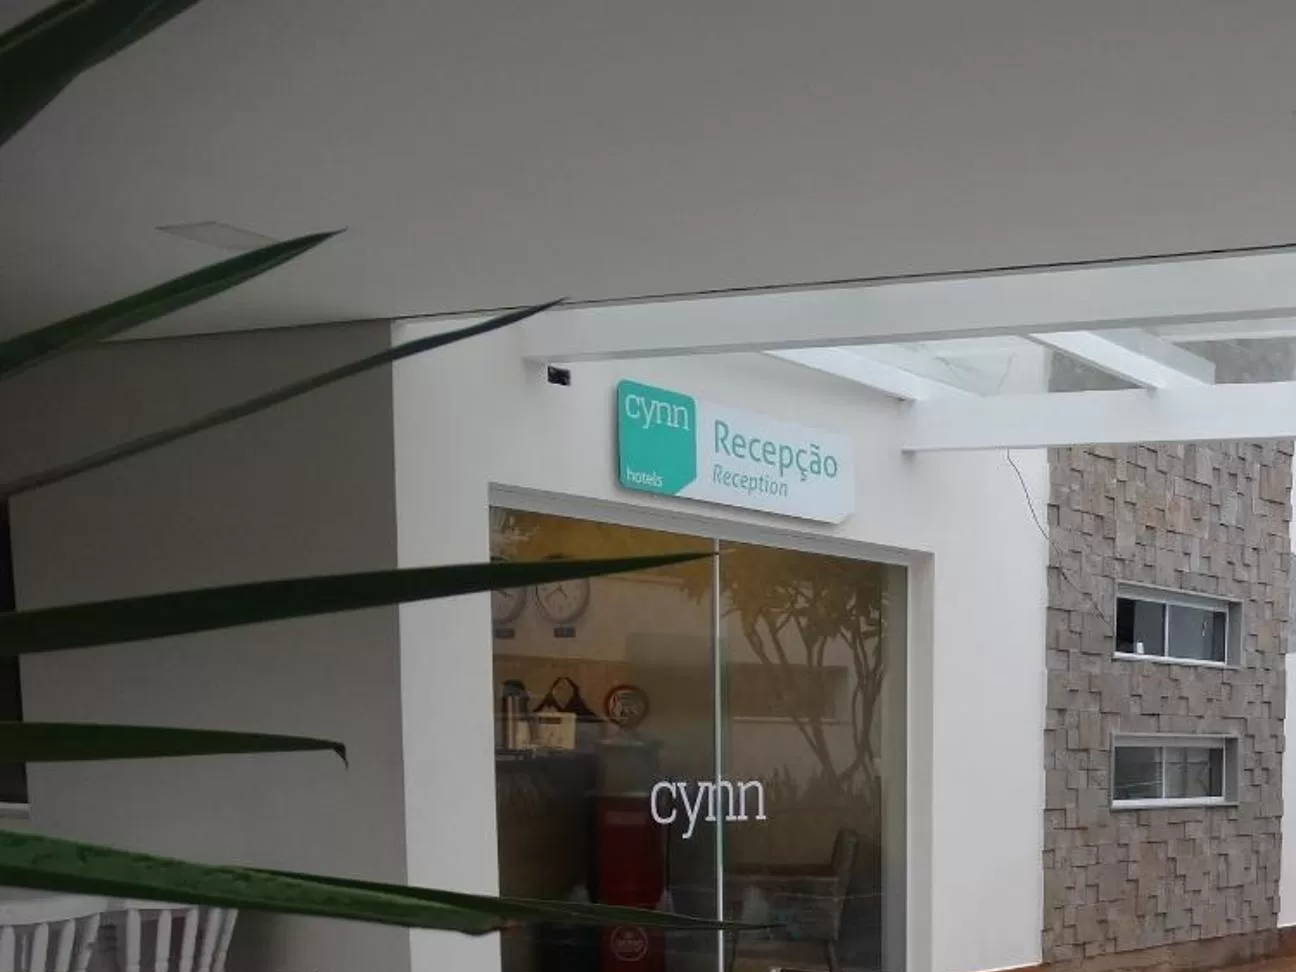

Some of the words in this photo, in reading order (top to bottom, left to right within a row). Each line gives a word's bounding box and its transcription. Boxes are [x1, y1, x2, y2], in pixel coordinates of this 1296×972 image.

[624, 393, 690, 431] cynn
[713, 418, 839, 482] Recepção
[626, 466, 663, 488] hotels
[711, 464, 789, 498] Reception
[650, 780, 767, 839] cynn
